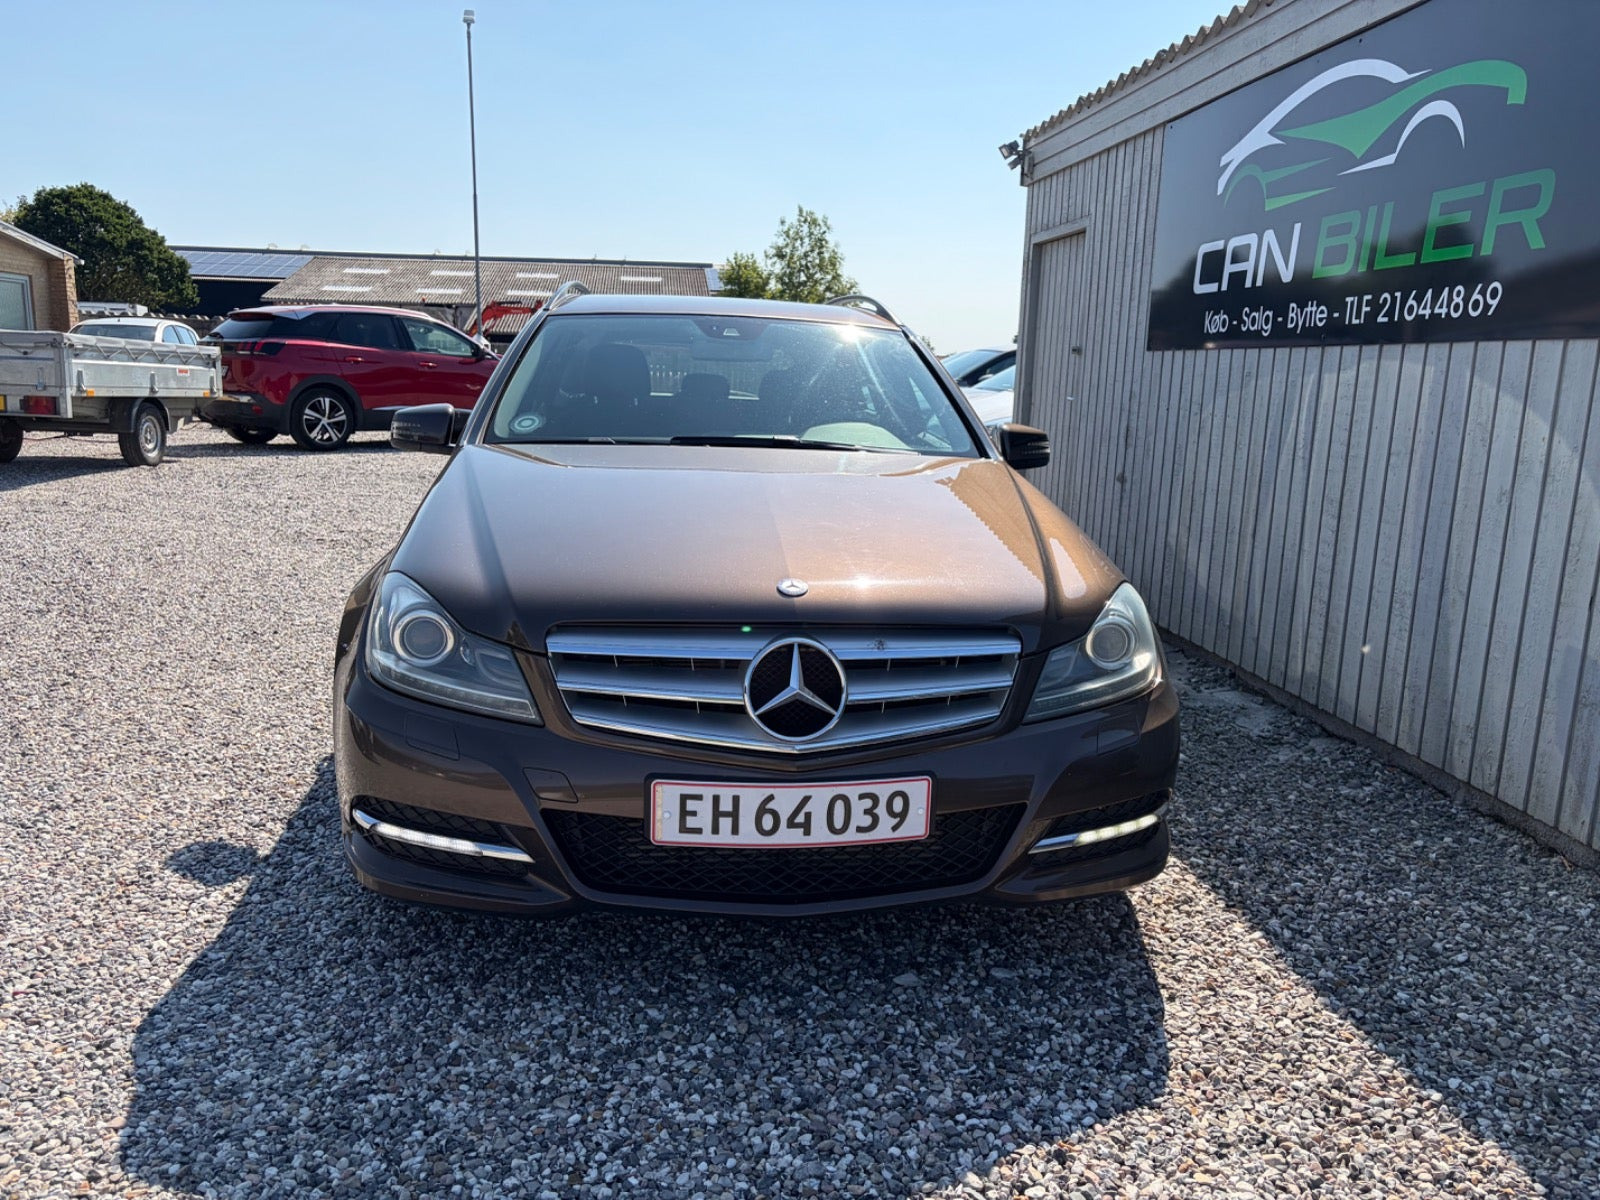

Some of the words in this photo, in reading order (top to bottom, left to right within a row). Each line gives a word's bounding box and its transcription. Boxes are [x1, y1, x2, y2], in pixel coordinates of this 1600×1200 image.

[1193, 222, 1302, 295] CAN
[1312, 168, 1556, 279] BILER
[1203, 309, 1229, 335] Køb
[1240, 305, 1274, 337] Salg
[1287, 300, 1329, 334] Bytte
[1345, 294, 1373, 325] TLF
[1377, 281, 1503, 323] 21644869
[678, 793, 741, 836] EH
[754, 793, 813, 837] 64
[826, 790, 911, 834] 039
